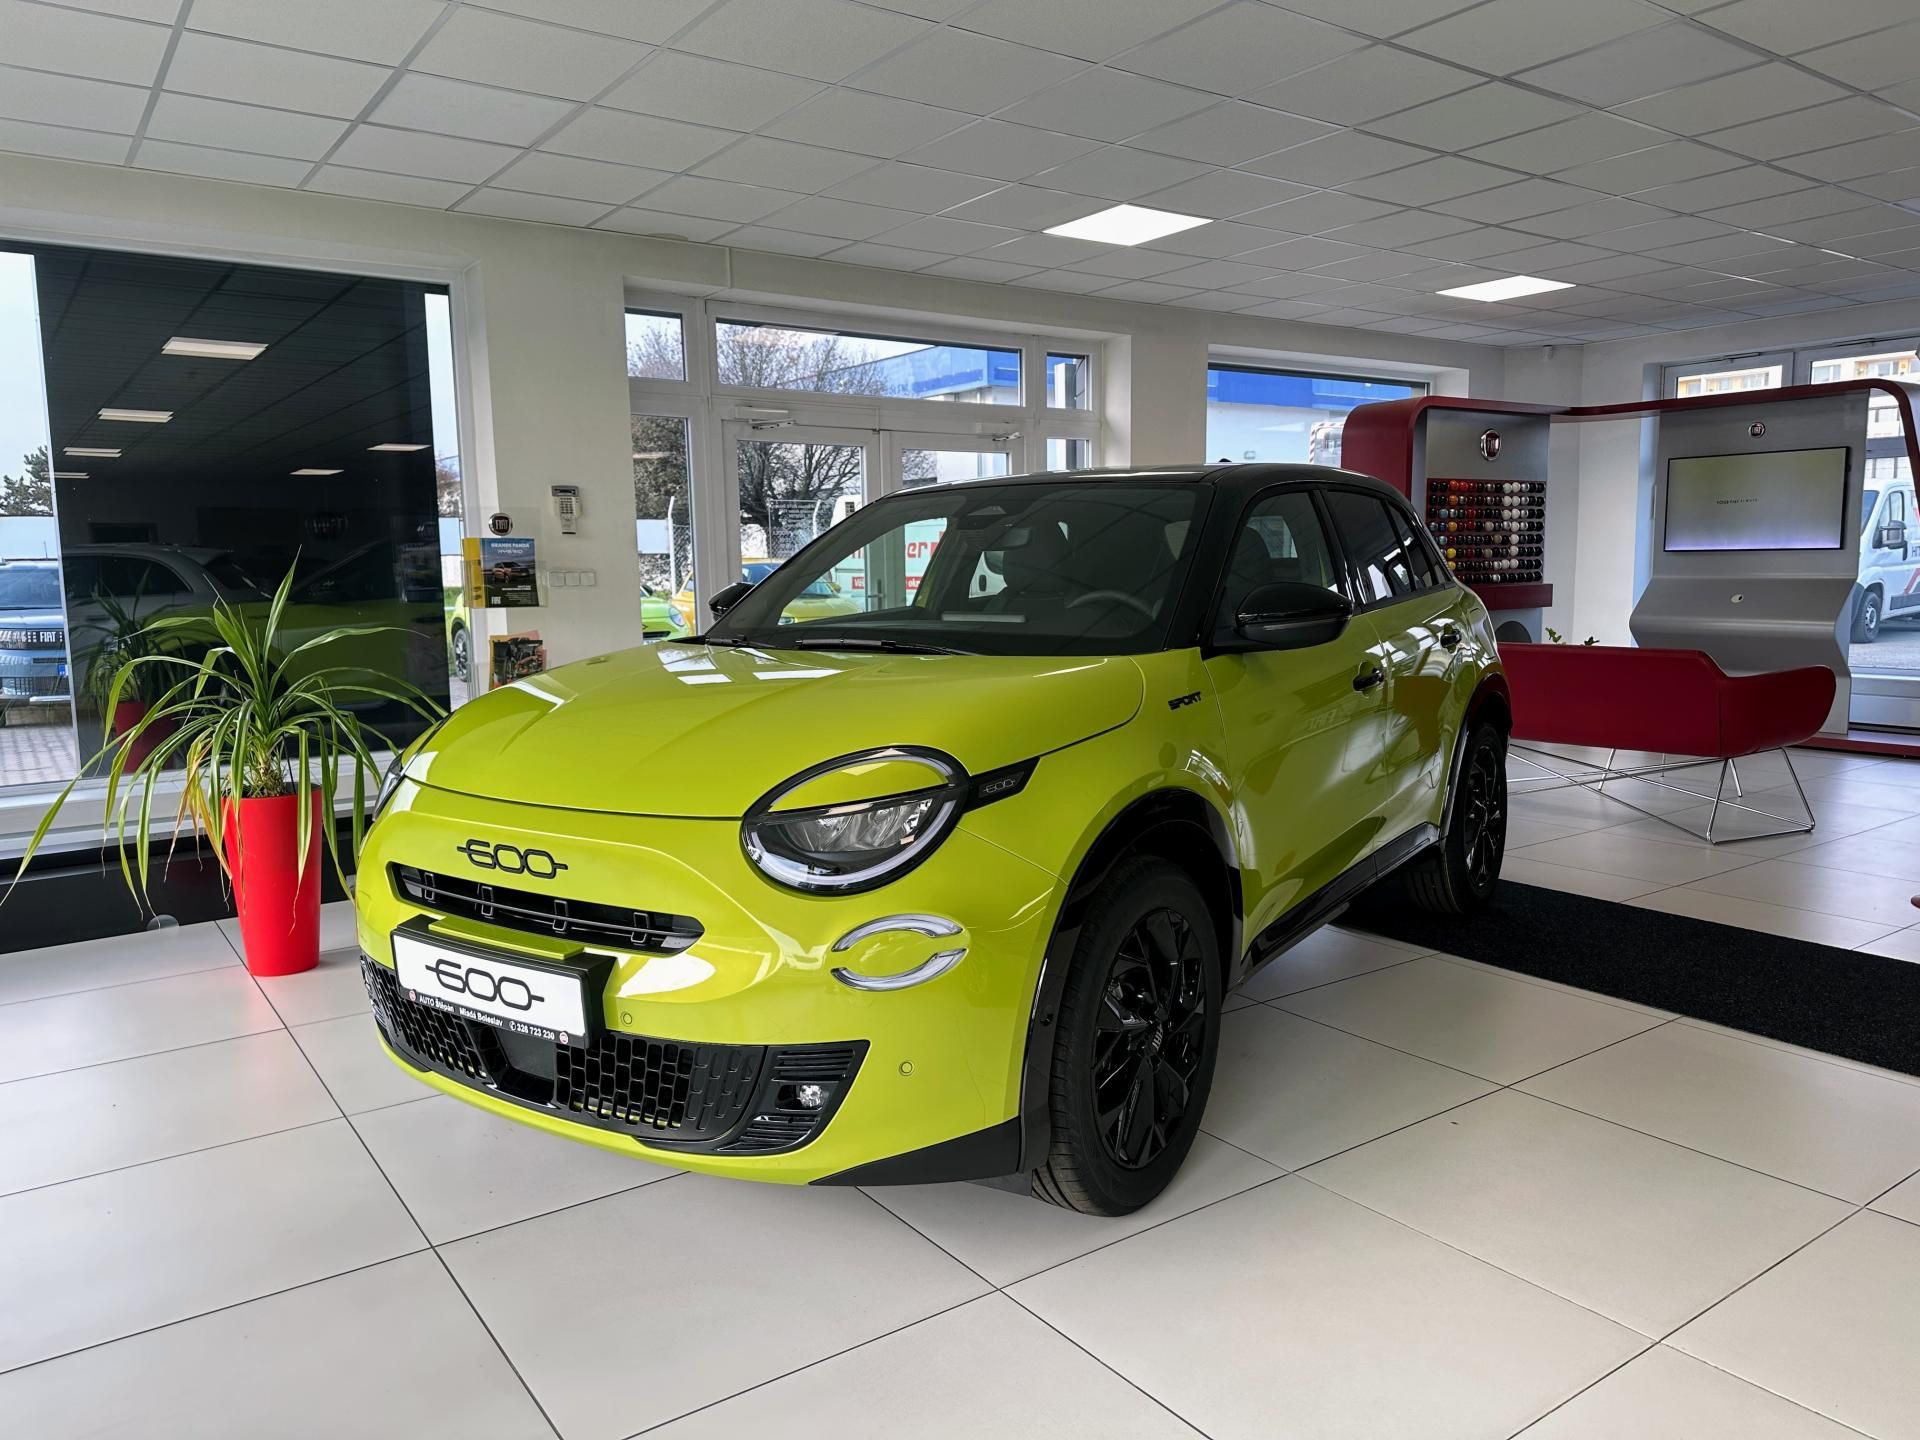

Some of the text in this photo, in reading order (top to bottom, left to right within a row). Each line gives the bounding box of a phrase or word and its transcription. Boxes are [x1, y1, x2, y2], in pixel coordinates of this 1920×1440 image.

[39, 631, 57, 643] FIAT
[1168, 691, 1201, 711] SPORT
[983, 778, 1016, 794] 600
[457, 838, 569, 880] 600
[425, 958, 545, 1012] 600
[419, 995, 435, 1008] AUTO
[477, 1012, 504, 1027] Boleslav
